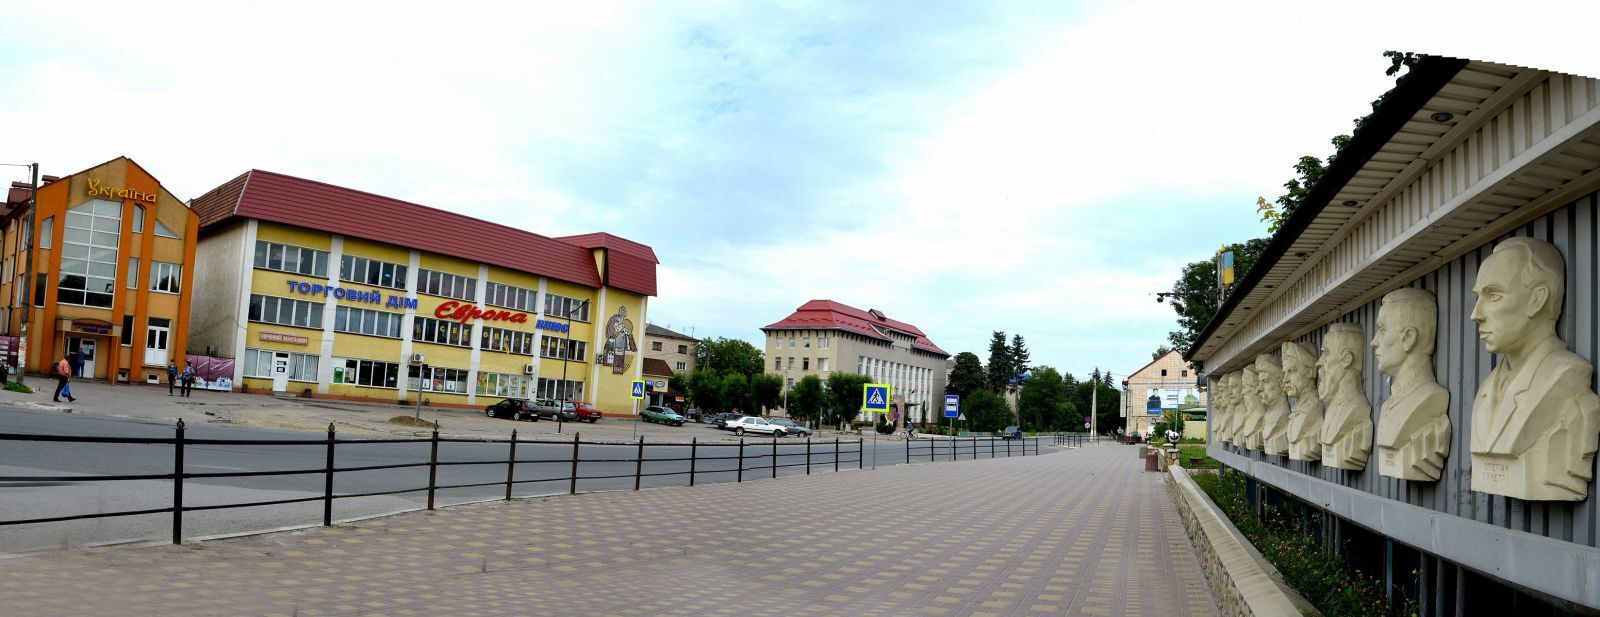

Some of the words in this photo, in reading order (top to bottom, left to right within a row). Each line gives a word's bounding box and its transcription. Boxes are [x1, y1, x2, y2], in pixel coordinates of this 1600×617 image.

[87, 177, 156, 203] Україна
[287, 280, 381, 305] ТОРГОВИЙ
[385, 295, 418, 310] ДІМ
[434, 301, 529, 324] Європа
